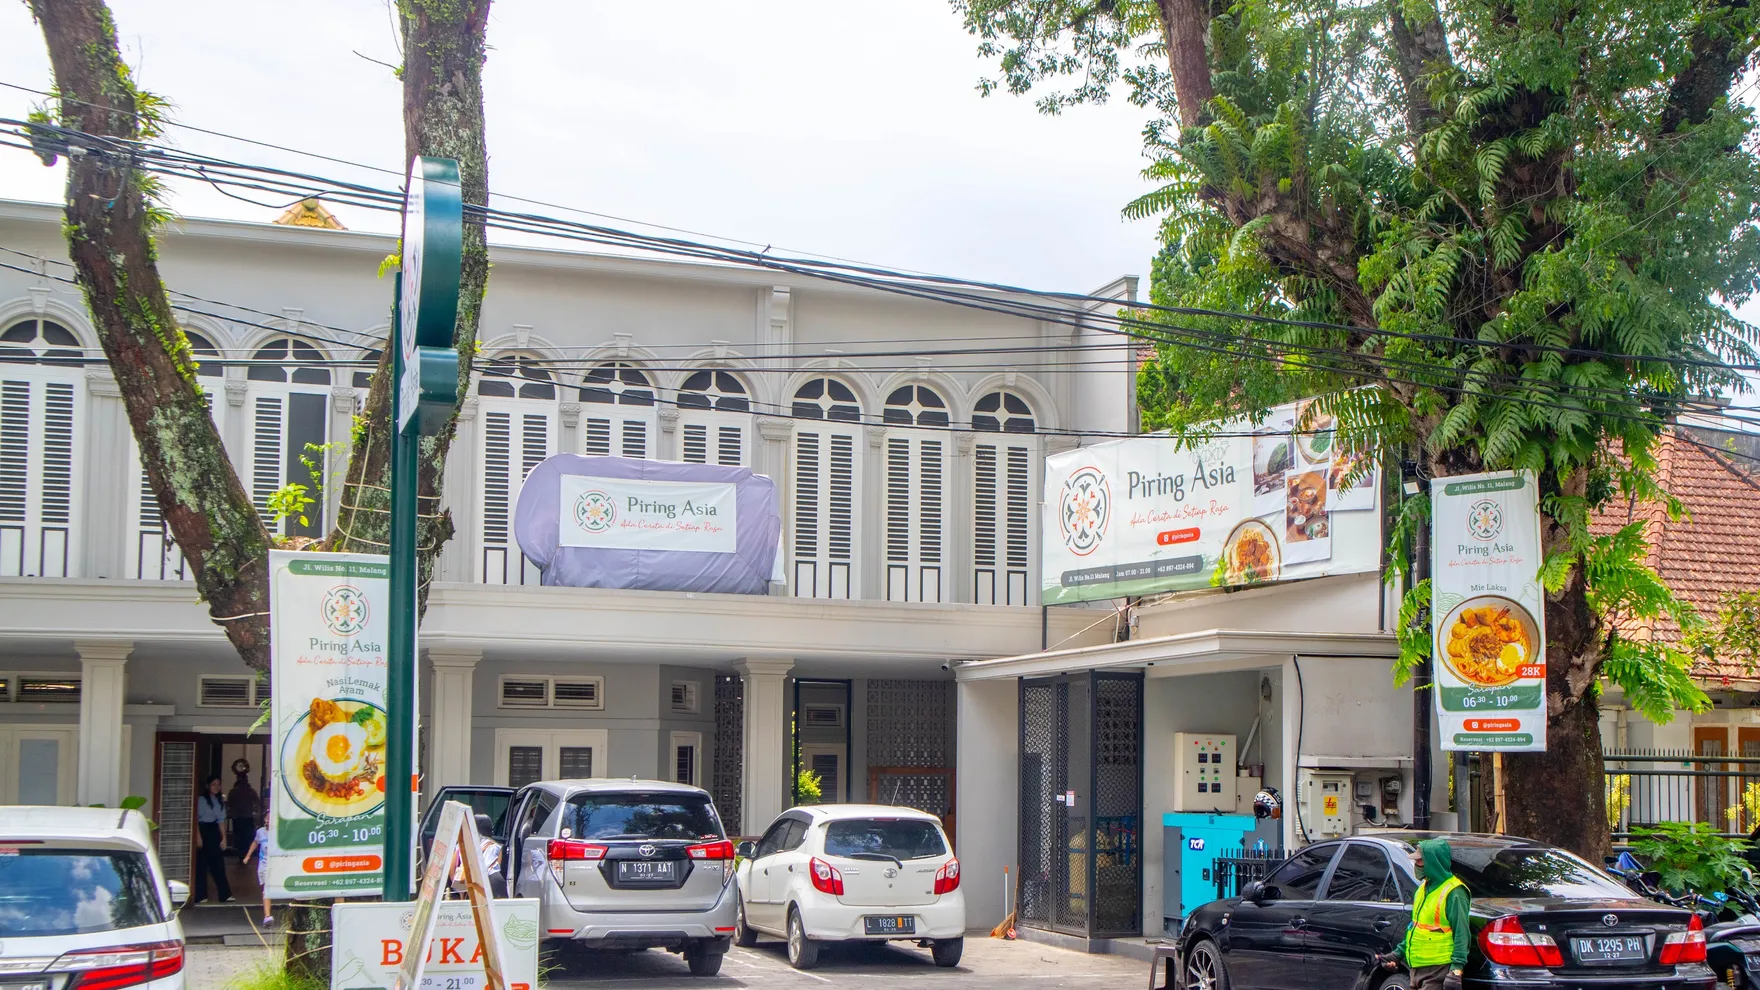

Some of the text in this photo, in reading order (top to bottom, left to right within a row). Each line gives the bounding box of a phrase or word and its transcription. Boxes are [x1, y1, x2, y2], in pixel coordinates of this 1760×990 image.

[1127, 460, 1236, 502] Piring Asia
[627, 496, 717, 519] Piring Asia
[1130, 512, 1146, 528] Ada
[1173, 509, 1182, 519] di
[1182, 504, 1207, 519] Setiap
[1210, 500, 1230, 515] Rasa
[620, 520, 637, 530] Ada
[638, 519, 664, 529] Cerita
[676, 521, 701, 532] Setiap
[703, 522, 724, 533] Rasa
[1458, 542, 1514, 557] Piring Asia
[359, 567, 387, 576] Malang
[1470, 584, 1507, 592] Mie Laksa
[309, 637, 381, 655] Piring Asia
[375, 656, 388, 668] Ras
[1521, 666, 1541, 676] 28K
[326, 677, 381, 692] Nasi Lemak
[339, 685, 365, 695] Ayam
[1468, 682, 1512, 696] Sarapan
[1463, 696, 1486, 708] 06.30
[1496, 695, 1518, 707] 10.00
[315, 812, 374, 829] Sarapan
[308, 829, 339, 844] 06.30
[352, 827, 382, 842] 10.00
[329, 859, 370, 869] @piringasia
[621, 863, 672, 873] N 1371 AAT
[294, 880, 327, 888] Reservasi
[437, 912, 472, 921] iring Asia
[866, 919, 872, 928] L
[879, 918, 896, 928] 1828
[1580, 938, 1641, 953] DK 1295 PH
[446, 977, 475, 990] 21.00
